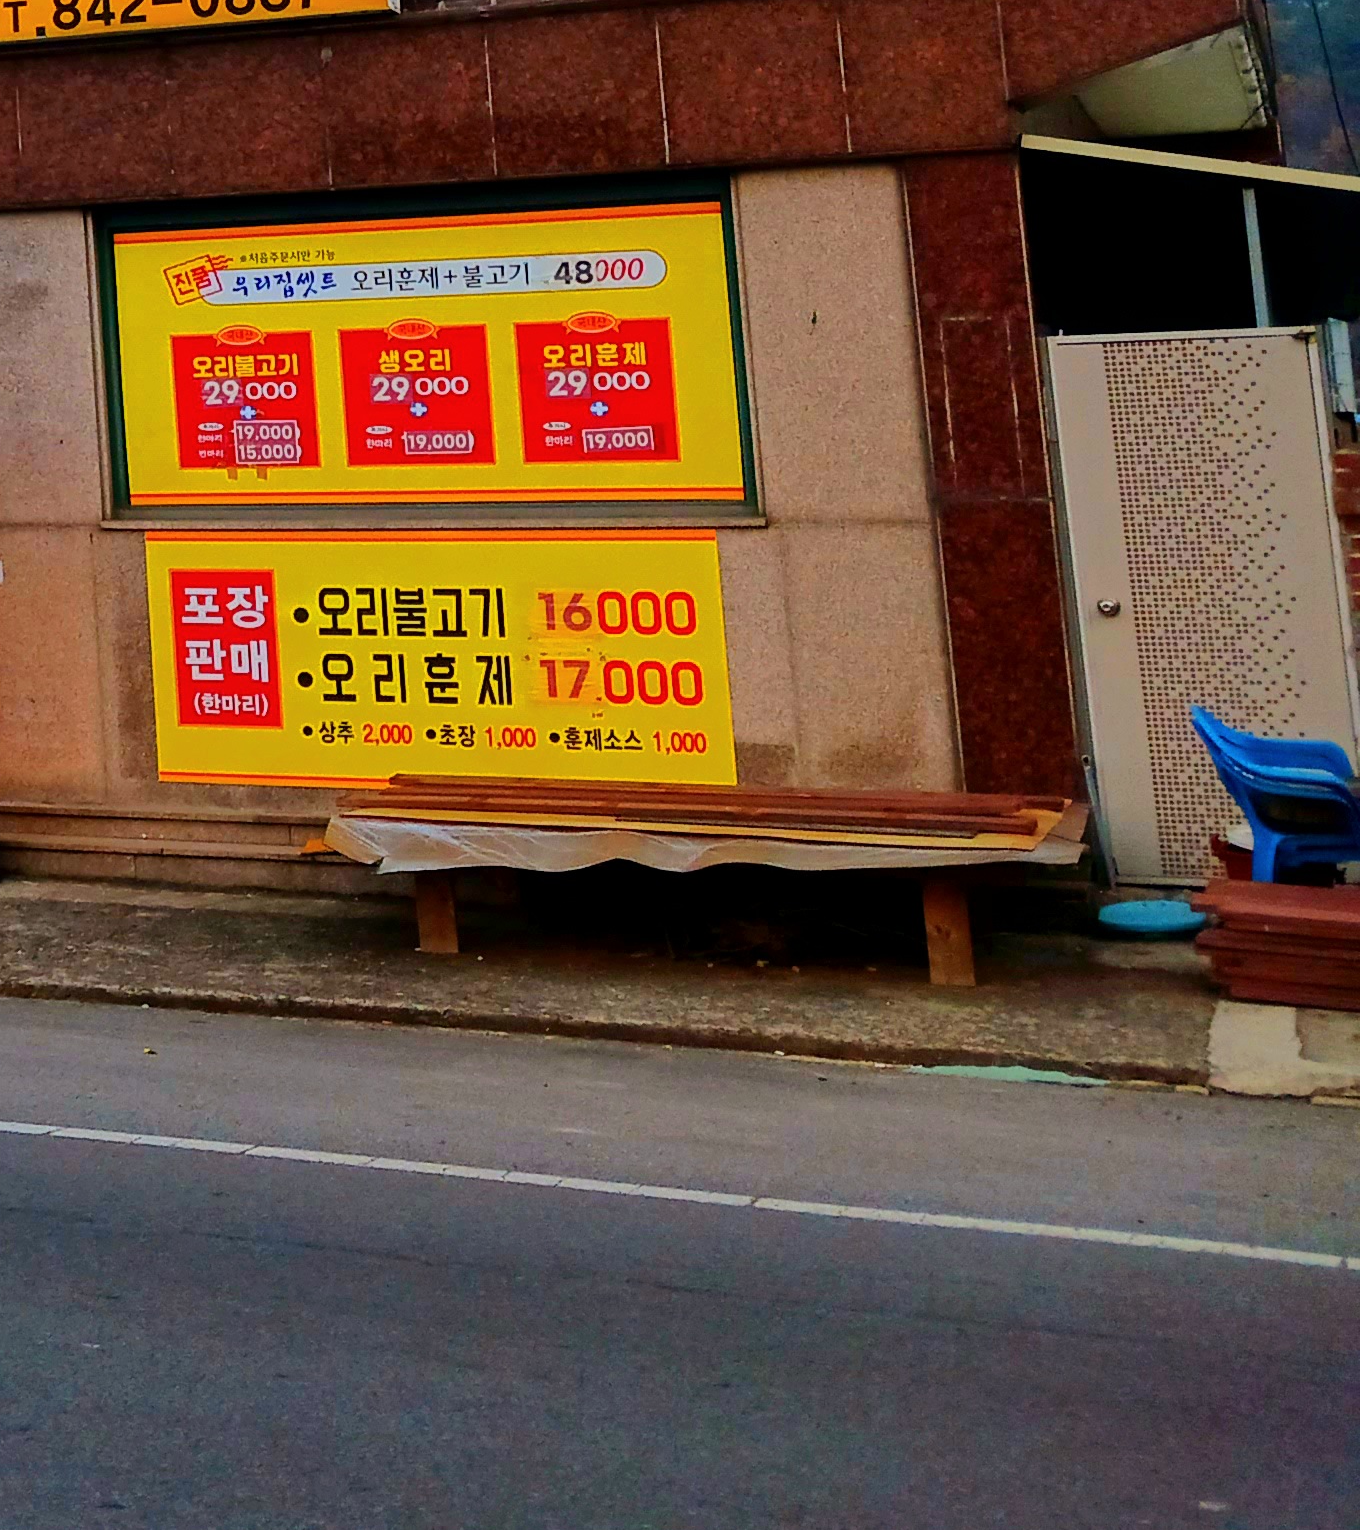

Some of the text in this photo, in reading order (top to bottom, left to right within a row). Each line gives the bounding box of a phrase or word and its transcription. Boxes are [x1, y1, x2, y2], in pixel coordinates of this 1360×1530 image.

[173, 267, 211, 296] 진품
[192, 353, 299, 378] 오리불고기
[379, 350, 451, 372] 생오리
[543, 342, 647, 368] 오리훈제
[237, 425, 293, 440] 19,000
[407, 433, 467, 450] 19,000
[586, 432, 649, 448] 19,000
[238, 445, 295, 460] 15,000
[181, 586, 268, 628] 포장
[318, 587, 697, 638] 오리불고기 16000
[185, 638, 270, 683] 판매
[322, 652, 513, 706] 오리훈제
[193, 692, 270, 716] (한마리)
[319, 721, 706, 754] 상추 2,000 초장 1,000 훈제소스 1,000
